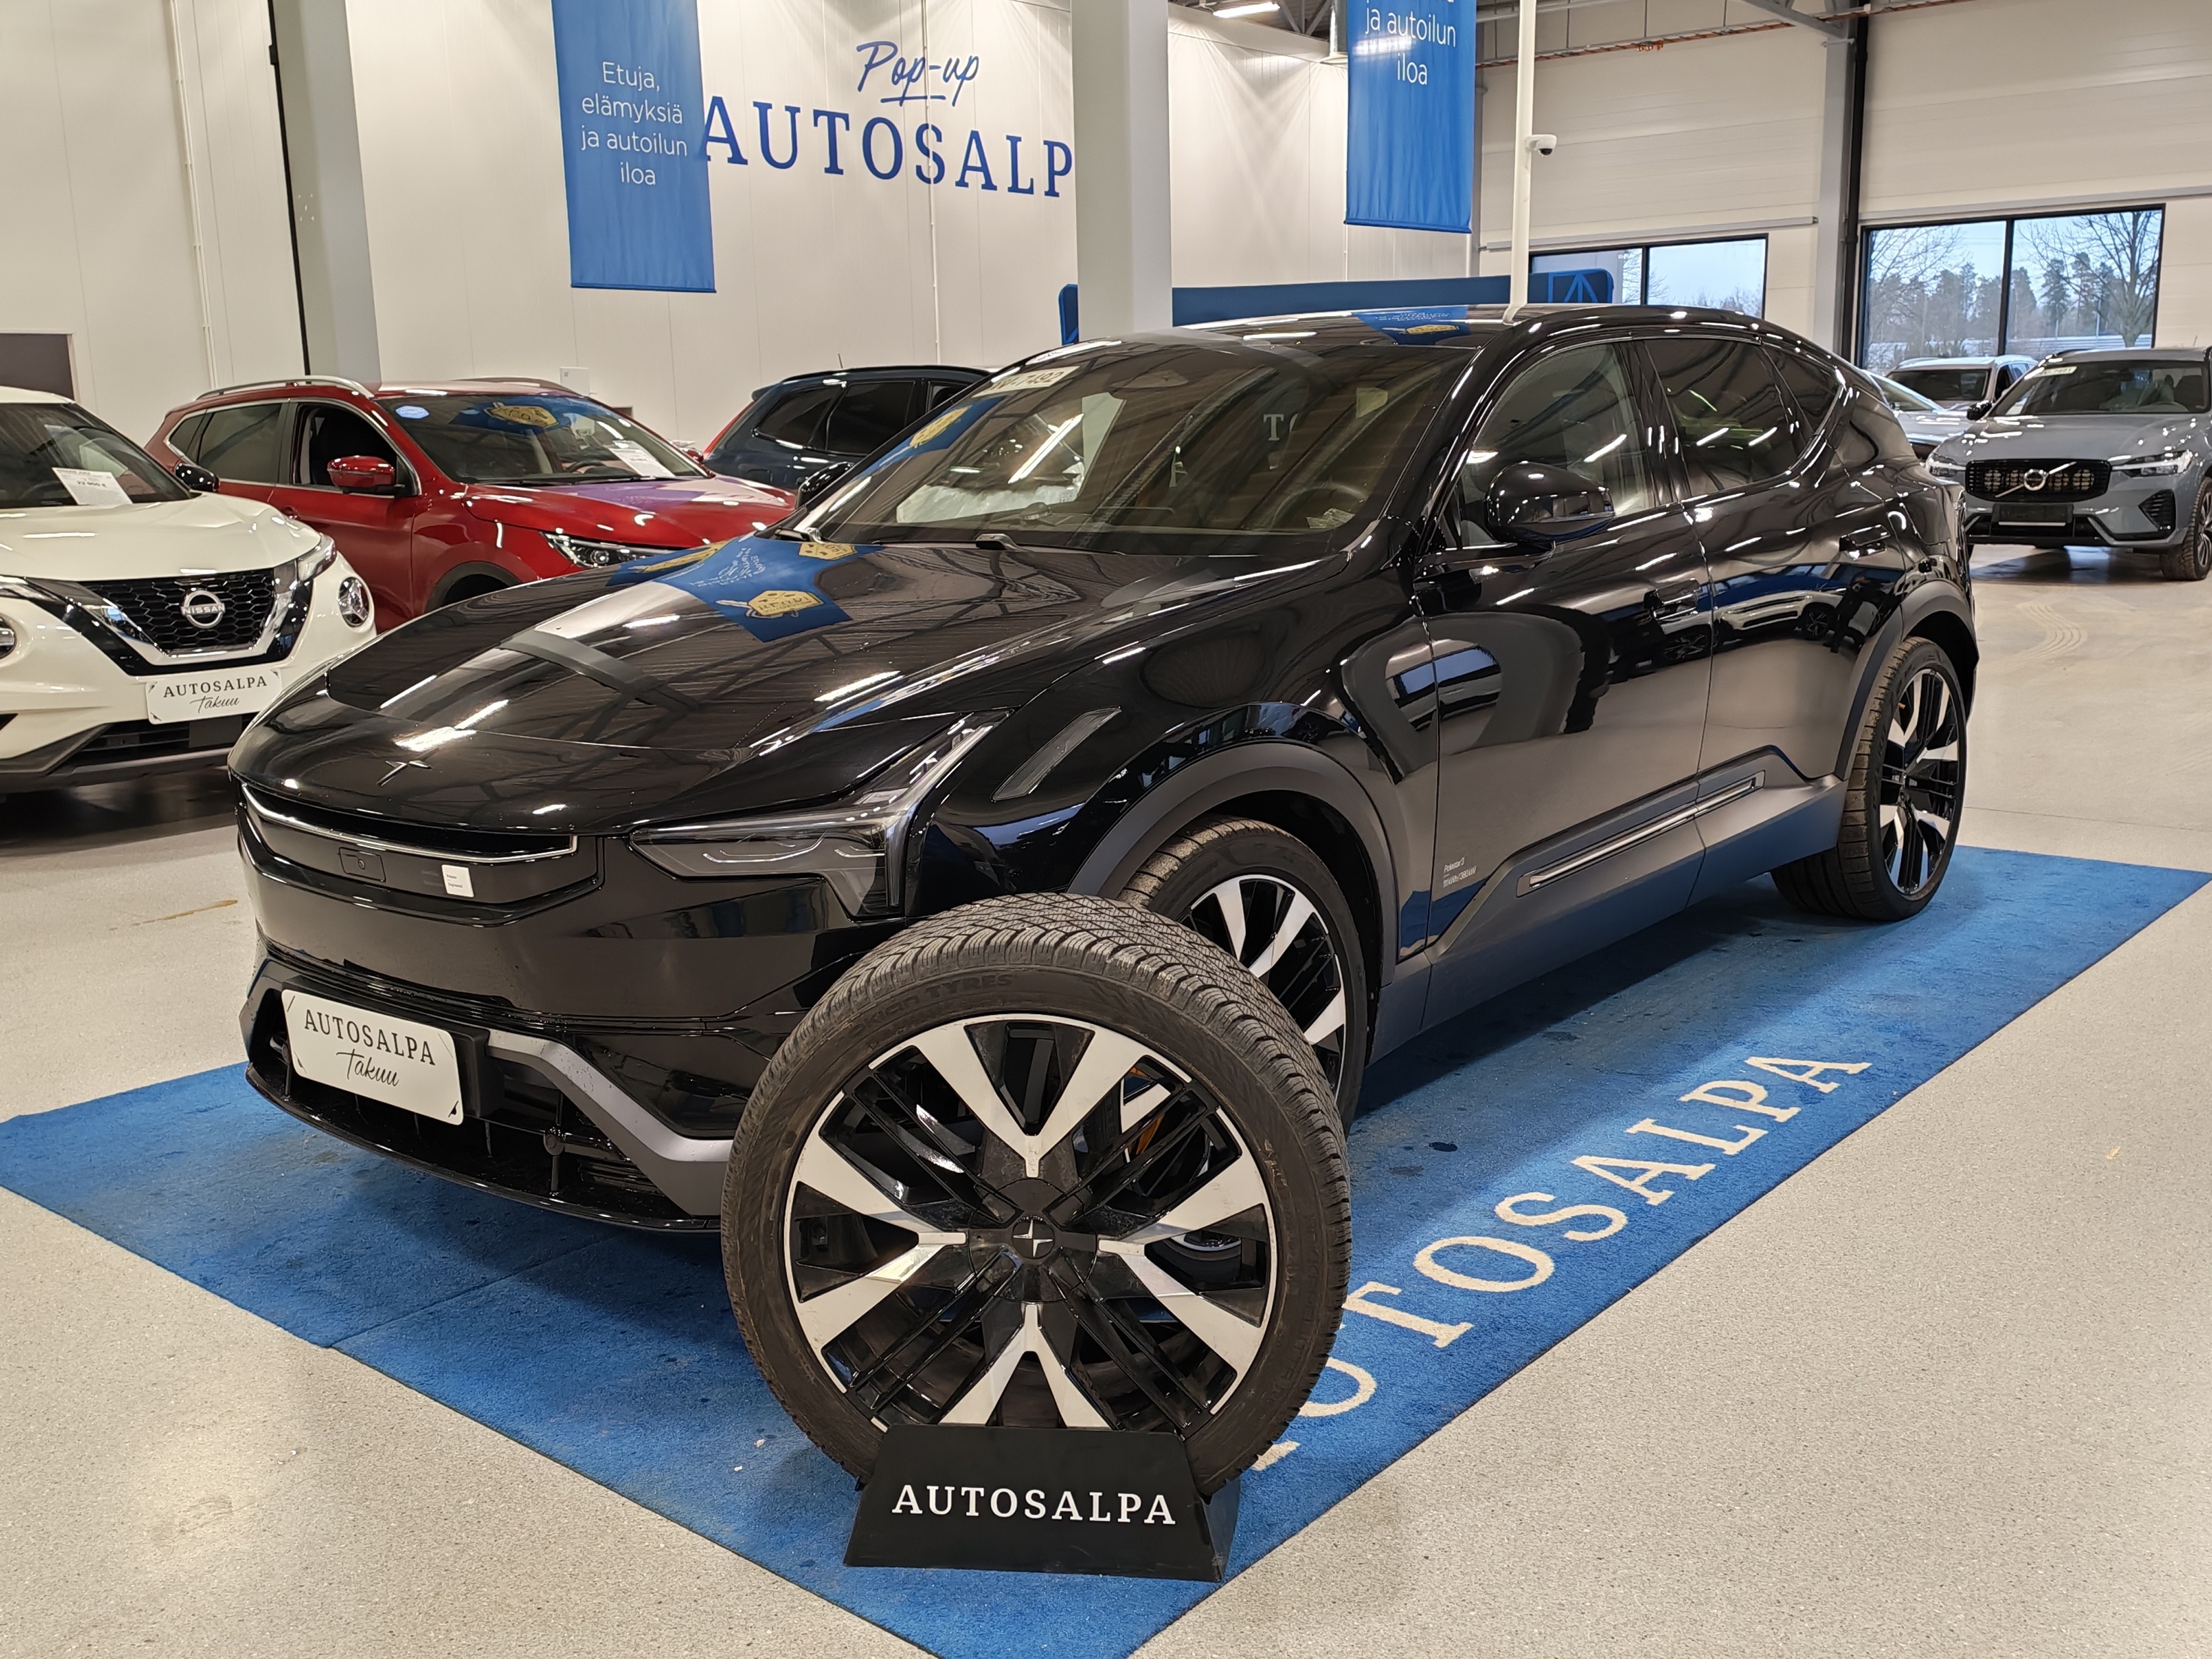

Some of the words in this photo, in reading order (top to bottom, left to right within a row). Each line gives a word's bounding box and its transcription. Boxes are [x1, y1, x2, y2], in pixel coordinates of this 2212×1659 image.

[1365, 0, 1381, 34] ja
[1387, 11, 1456, 48] autoilun
[602, 61, 660, 92] Etuja,
[857, 41, 979, 106] Pop-up
[1397, 52, 1427, 85] iloa
[582, 92, 683, 124] elämyksiä
[581, 125, 599, 151] ja
[606, 131, 687, 157] autoilun
[620, 161, 656, 186] iloa
[183, 605, 225, 614] NISSAN
[164, 676, 267, 698] AUTOSALPA
[190, 696, 240, 713] Takuu
[305, 1009, 436, 1066] AUTOSALPA
[336, 1049, 400, 1087] Takuu
[892, 1484, 1176, 1525] AUTOSALPA
